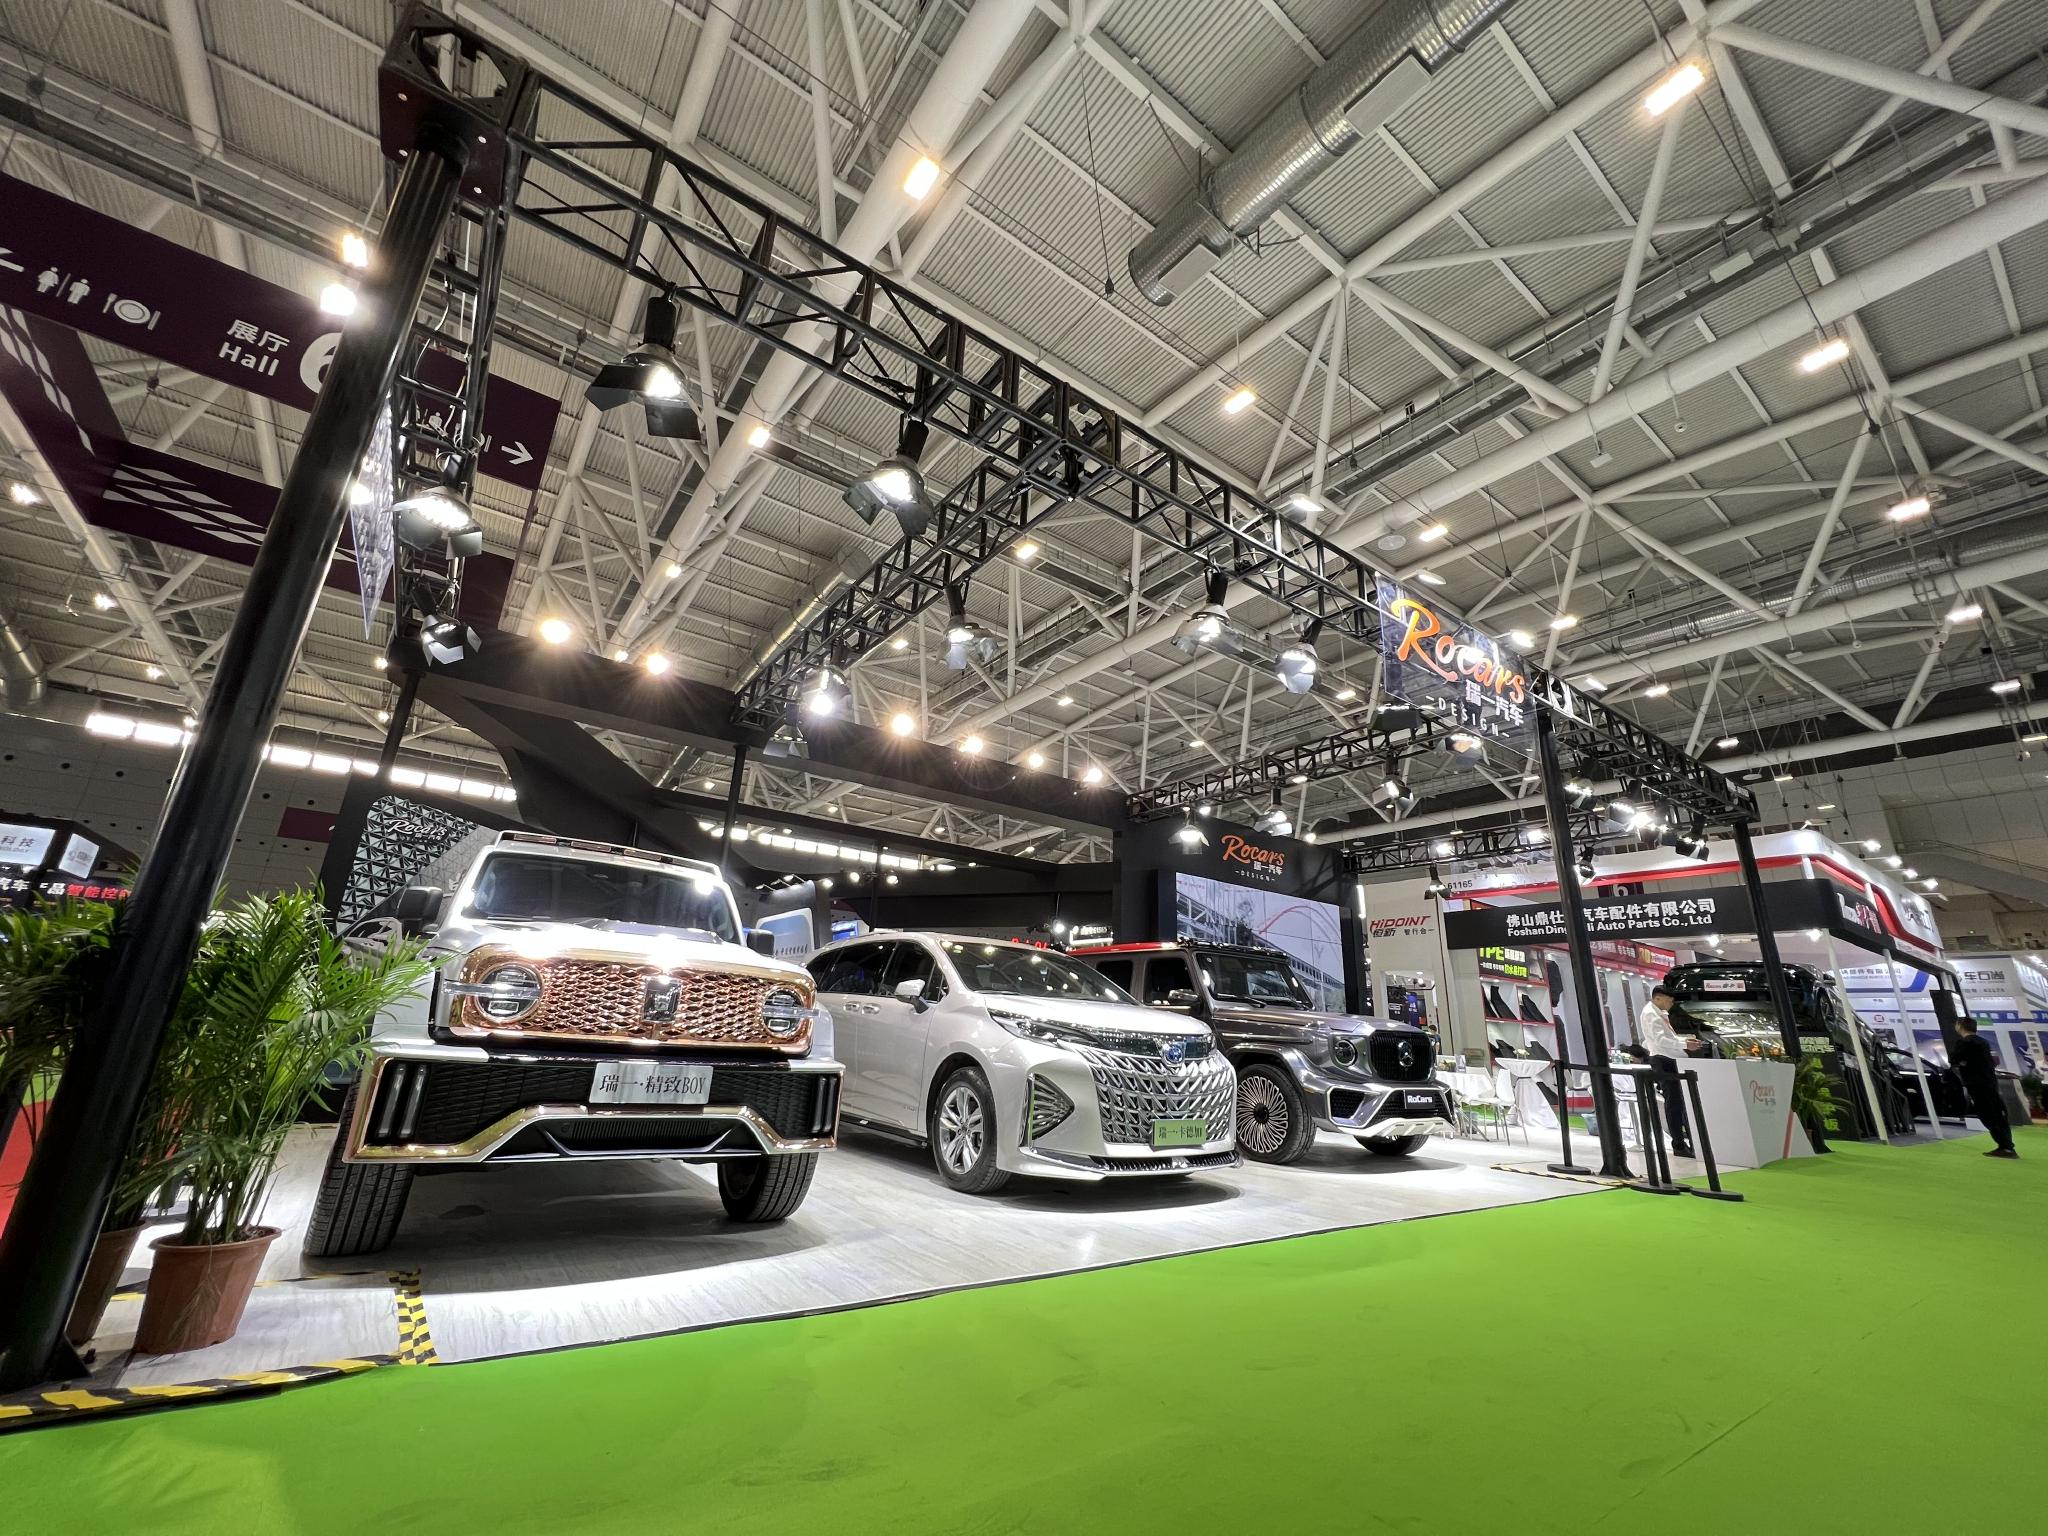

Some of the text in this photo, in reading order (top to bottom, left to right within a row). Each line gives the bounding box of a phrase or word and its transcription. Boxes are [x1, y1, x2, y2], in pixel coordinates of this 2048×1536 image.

[226, 319, 291, 353] 展厅
[218, 341, 280, 377] Hall
[1390, 598, 1525, 704] Rocars
[1465, 679, 1524, 727] 瑞一汽车
[387, 820, 448, 837] Rocars
[1221, 834, 1285, 866] Rocars
[1507, 925, 1545, 937] Foshan
[1596, 921, 1625, 931] Auto
[1628, 918, 1660, 929] Parts
